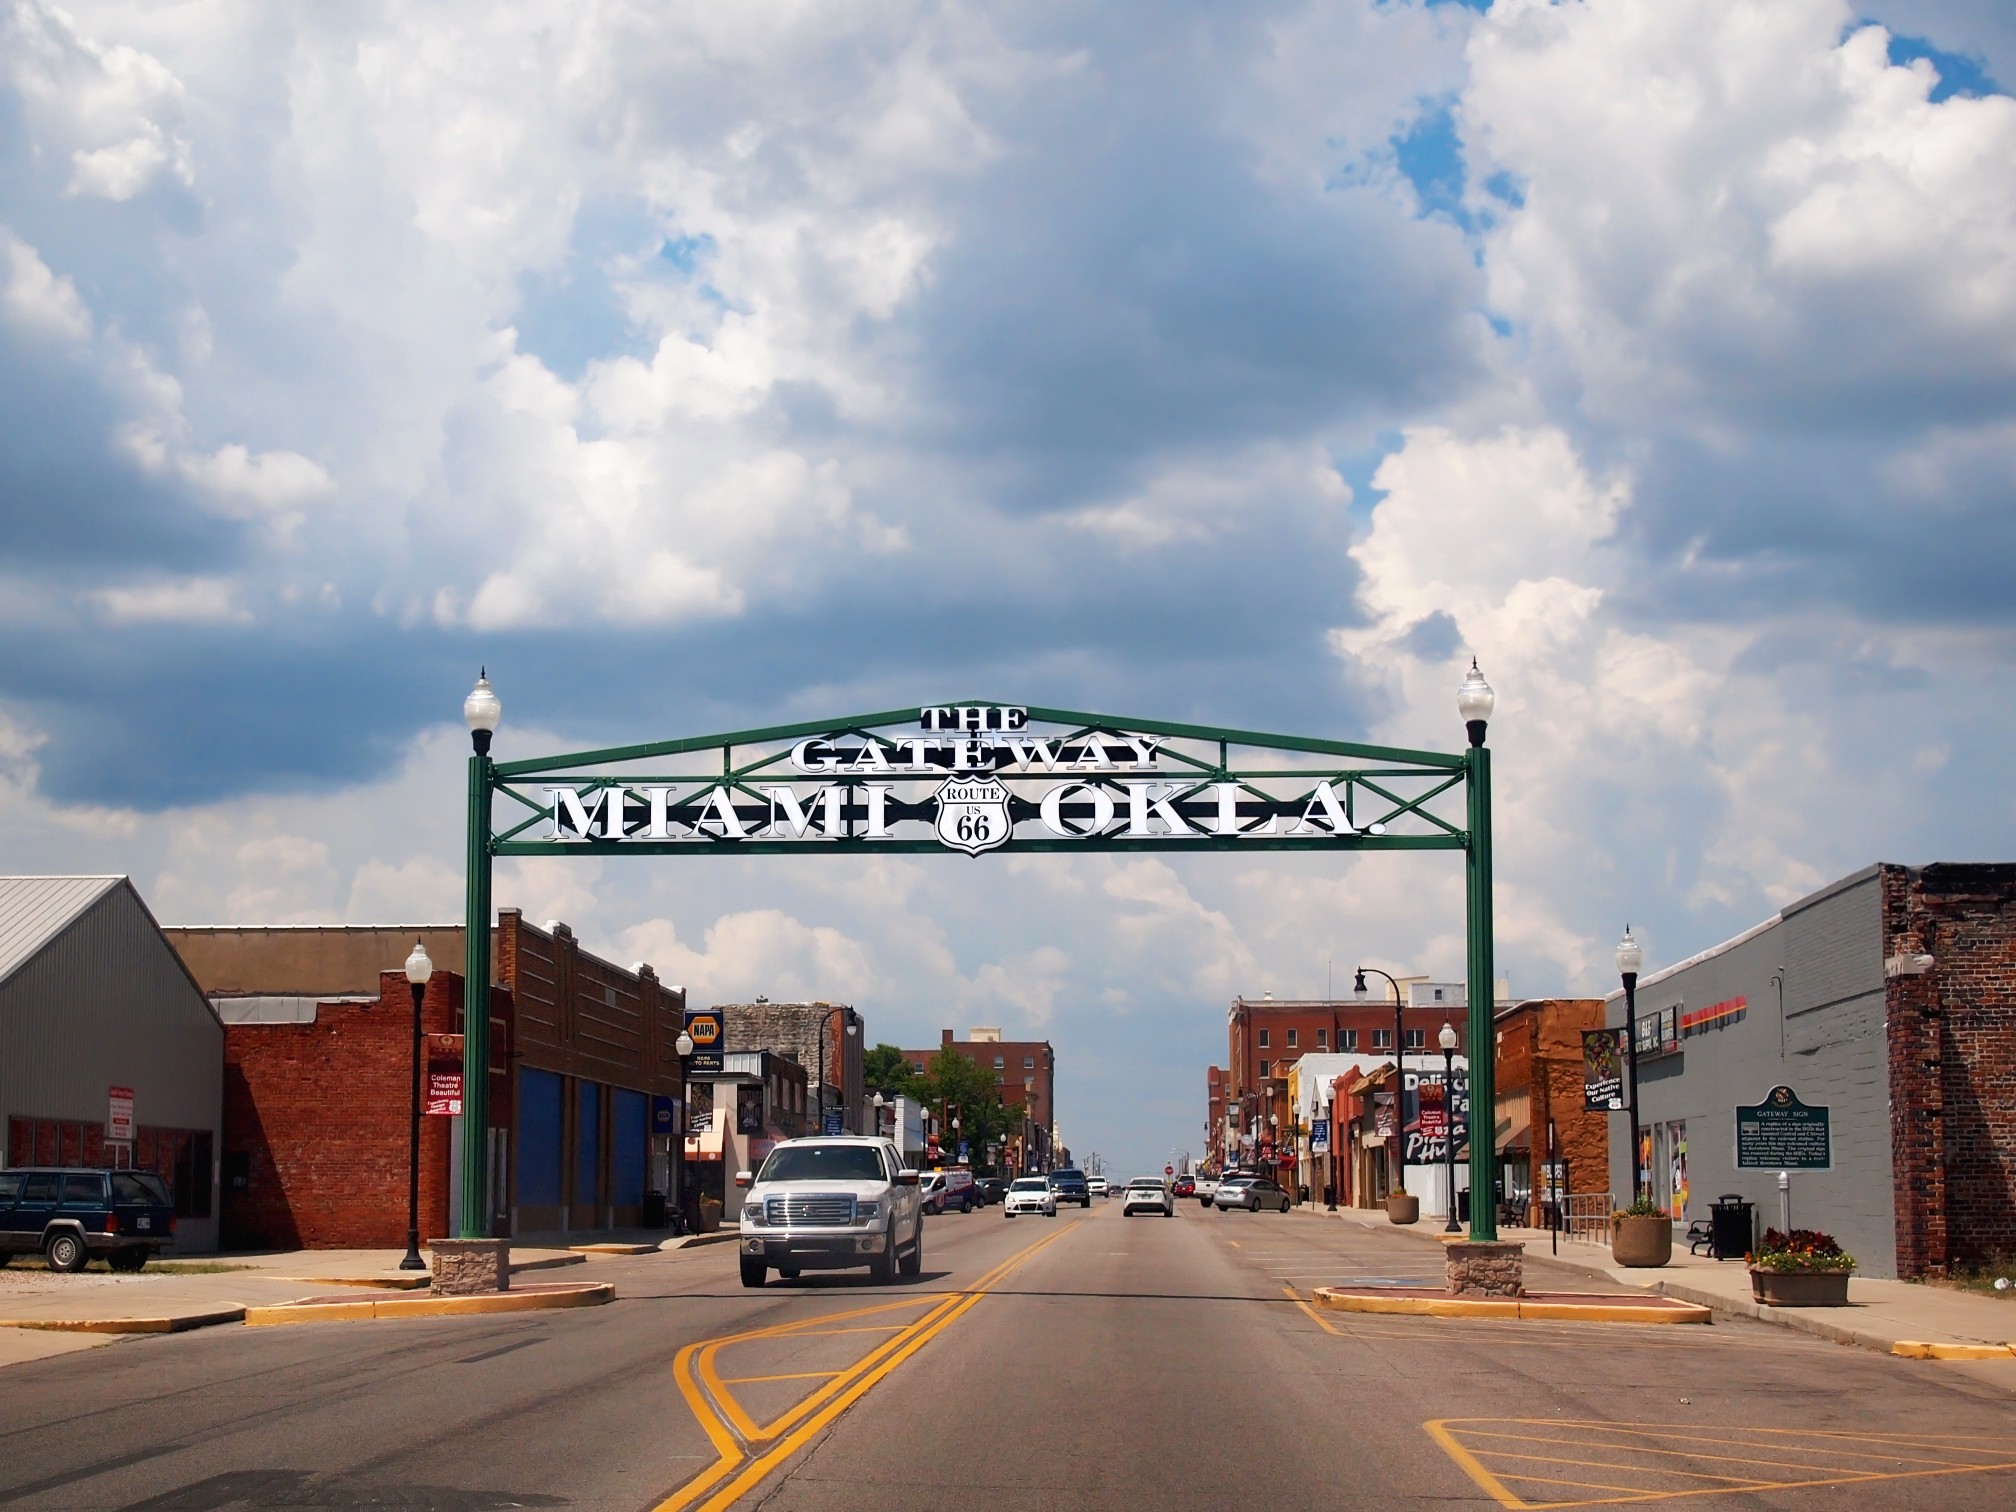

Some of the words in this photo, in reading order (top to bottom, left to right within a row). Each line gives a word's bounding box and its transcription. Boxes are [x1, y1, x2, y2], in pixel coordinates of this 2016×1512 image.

[920, 706, 1028, 734] THE
[790, 736, 1171, 773] GATEWAY
[946, 788, 1000, 800] ROUTE
[543, 785, 894, 839] MIAMI
[1039, 780, 1387, 838] OKLA.
[966, 806, 981, 815] US
[956, 814, 990, 842] 66
[694, 1024, 714, 1036] NAPA
[1585, 1078, 1620, 1090] Experience
[1600, 1083, 1620, 1093] Native
[1452, 1094, 1470, 1112] Fa
[1591, 1091, 1616, 1103] Culture
